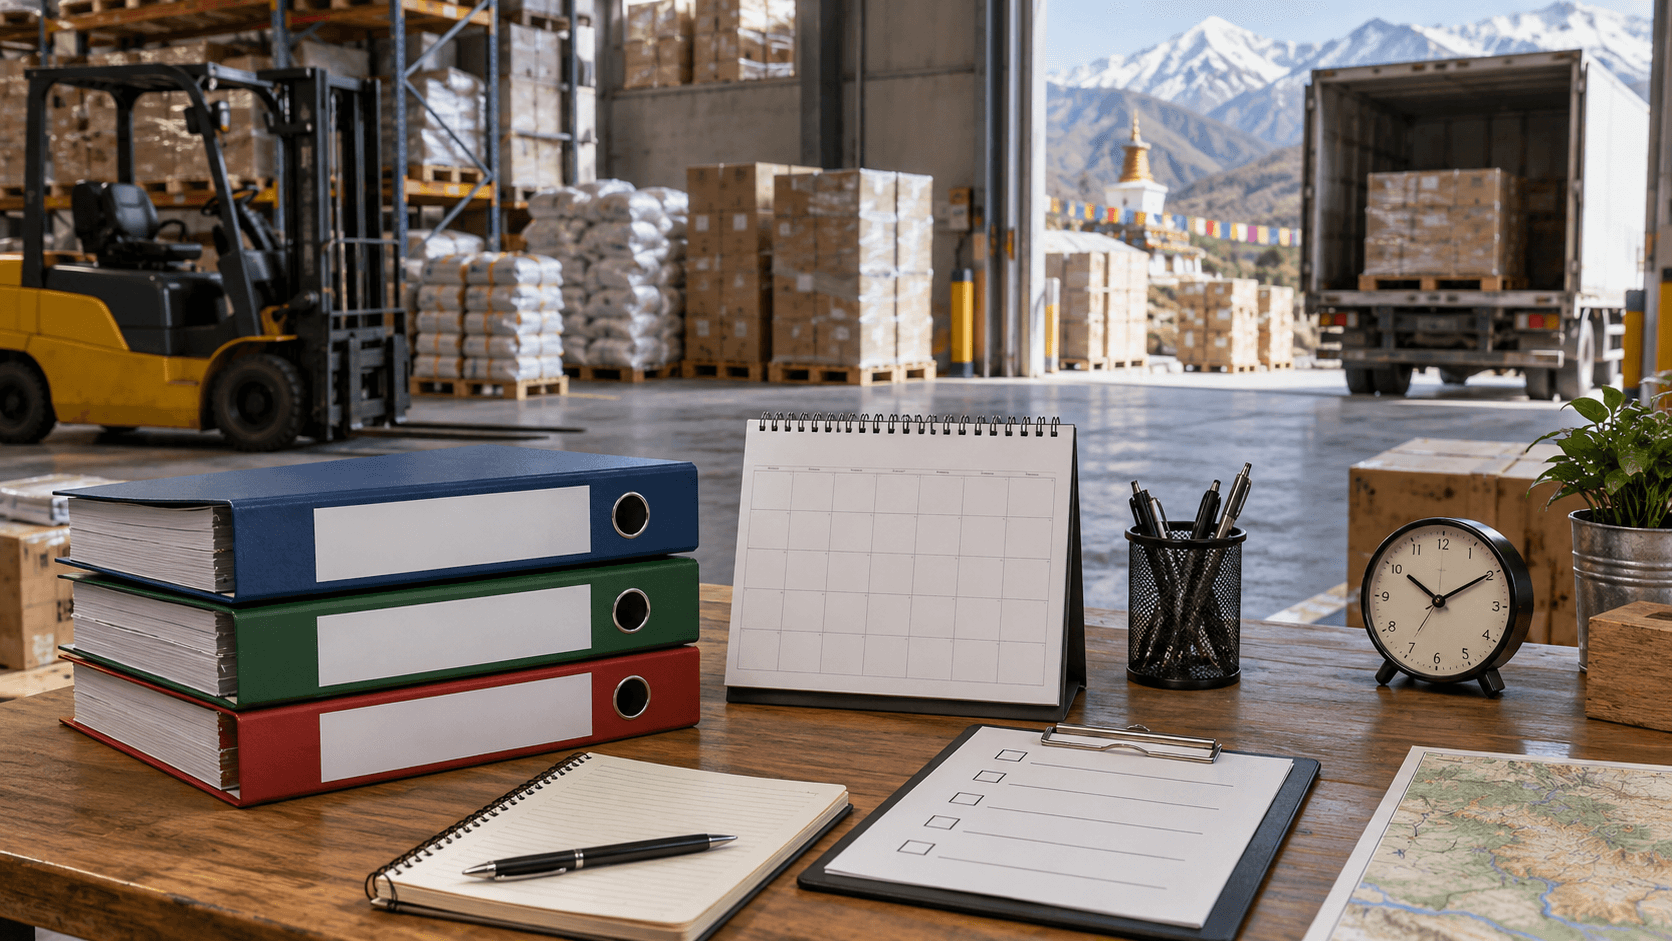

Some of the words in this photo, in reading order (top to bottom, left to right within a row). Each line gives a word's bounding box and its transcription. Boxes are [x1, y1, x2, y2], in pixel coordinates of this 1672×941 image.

[1412, 544, 1421, 555] 11
[1438, 539, 1449, 550] 12
[1391, 564, 1402, 574] 10
[1486, 571, 1494, 580] 2
[1382, 592, 1390, 601] 9
[1492, 601, 1500, 612] 3
[1388, 621, 1396, 632] 8
[1482, 629, 1490, 640] 4
[1408, 642, 1415, 653] 7
[1434, 653, 1440, 664] 6
[1462, 648, 1469, 659] 5
